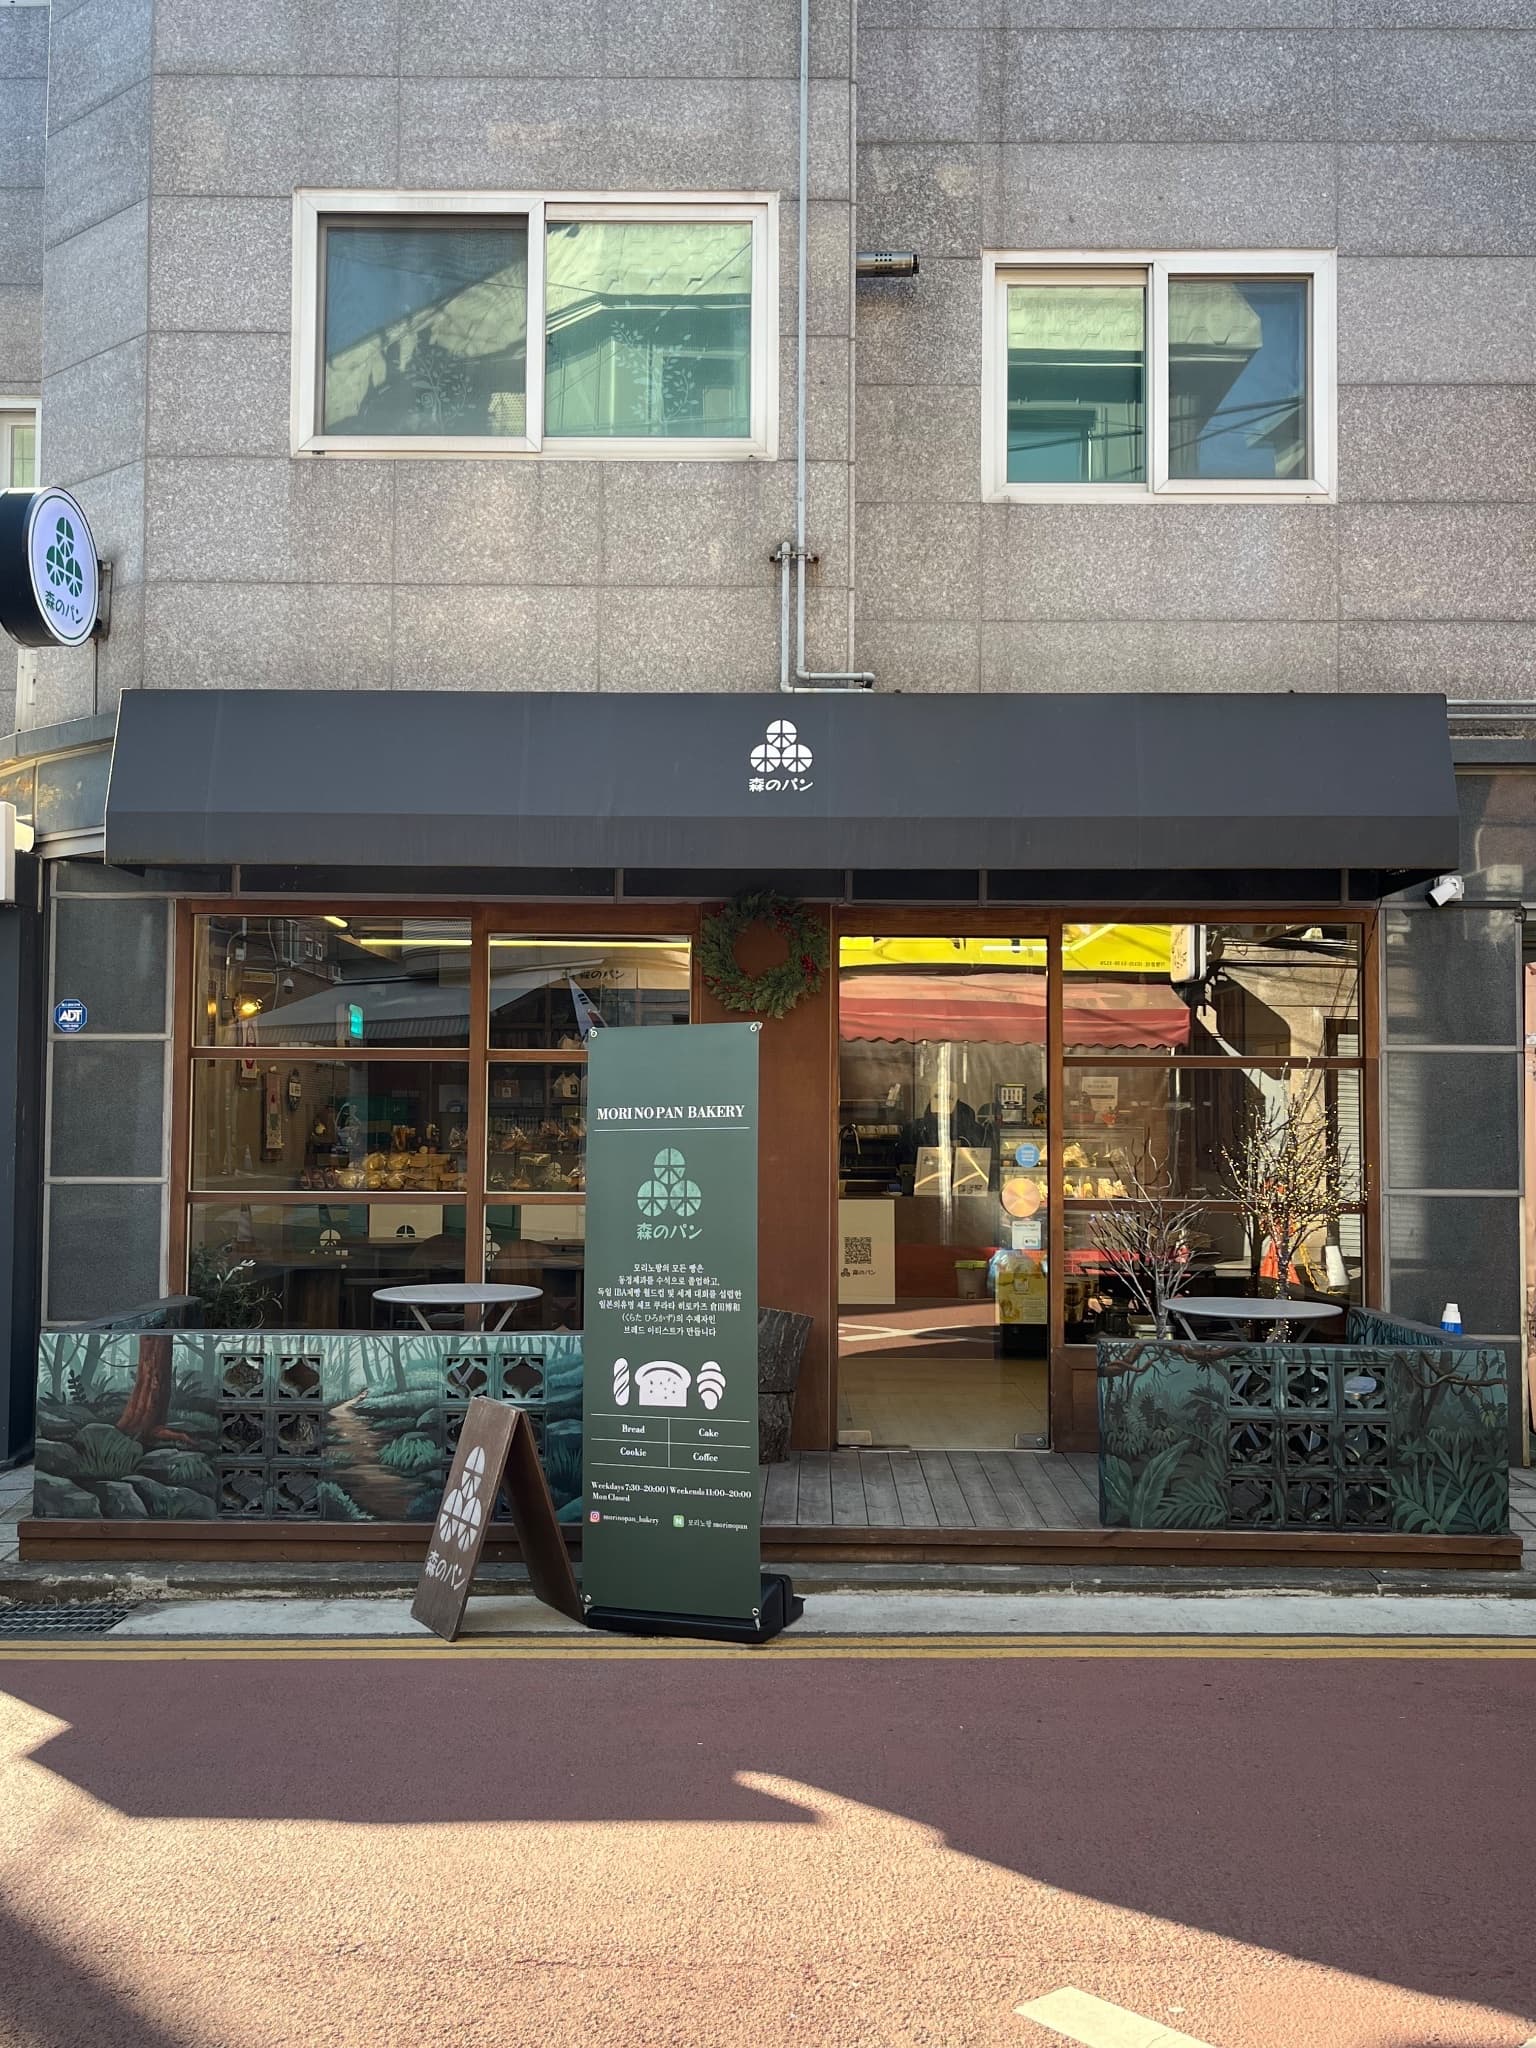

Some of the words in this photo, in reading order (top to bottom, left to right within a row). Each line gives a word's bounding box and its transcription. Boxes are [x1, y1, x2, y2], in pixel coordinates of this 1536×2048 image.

[44, 590, 84, 625] 森のパン
[748, 777, 814, 792] 森のパン
[59, 1009, 82, 1021] ADT
[688, 1105, 745, 1118] BAKERY
[636, 1222, 703, 1240] 森のパン
[671, 1263, 687, 1273] 모든
[597, 1287, 612, 1297] 독일
[667, 1288, 675, 1298] 및
[677, 1288, 692, 1298] 세계
[623, 1325, 645, 1334] 브레드
[647, 1325, 684, 1336] 아티스트가
[686, 1326, 716, 1337] 만듭니다
[621, 1424, 645, 1434] Bread
[698, 1428, 719, 1437] Cake
[620, 1447, 647, 1457] Cookie
[693, 1452, 719, 1462] Coffee
[591, 1481, 624, 1492] Weekdays
[669, 1486, 705, 1496] Weekends
[592, 1492, 607, 1500] Mon
[608, 1493, 630, 1502] Closed
[424, 1550, 466, 1591] 森のパン
